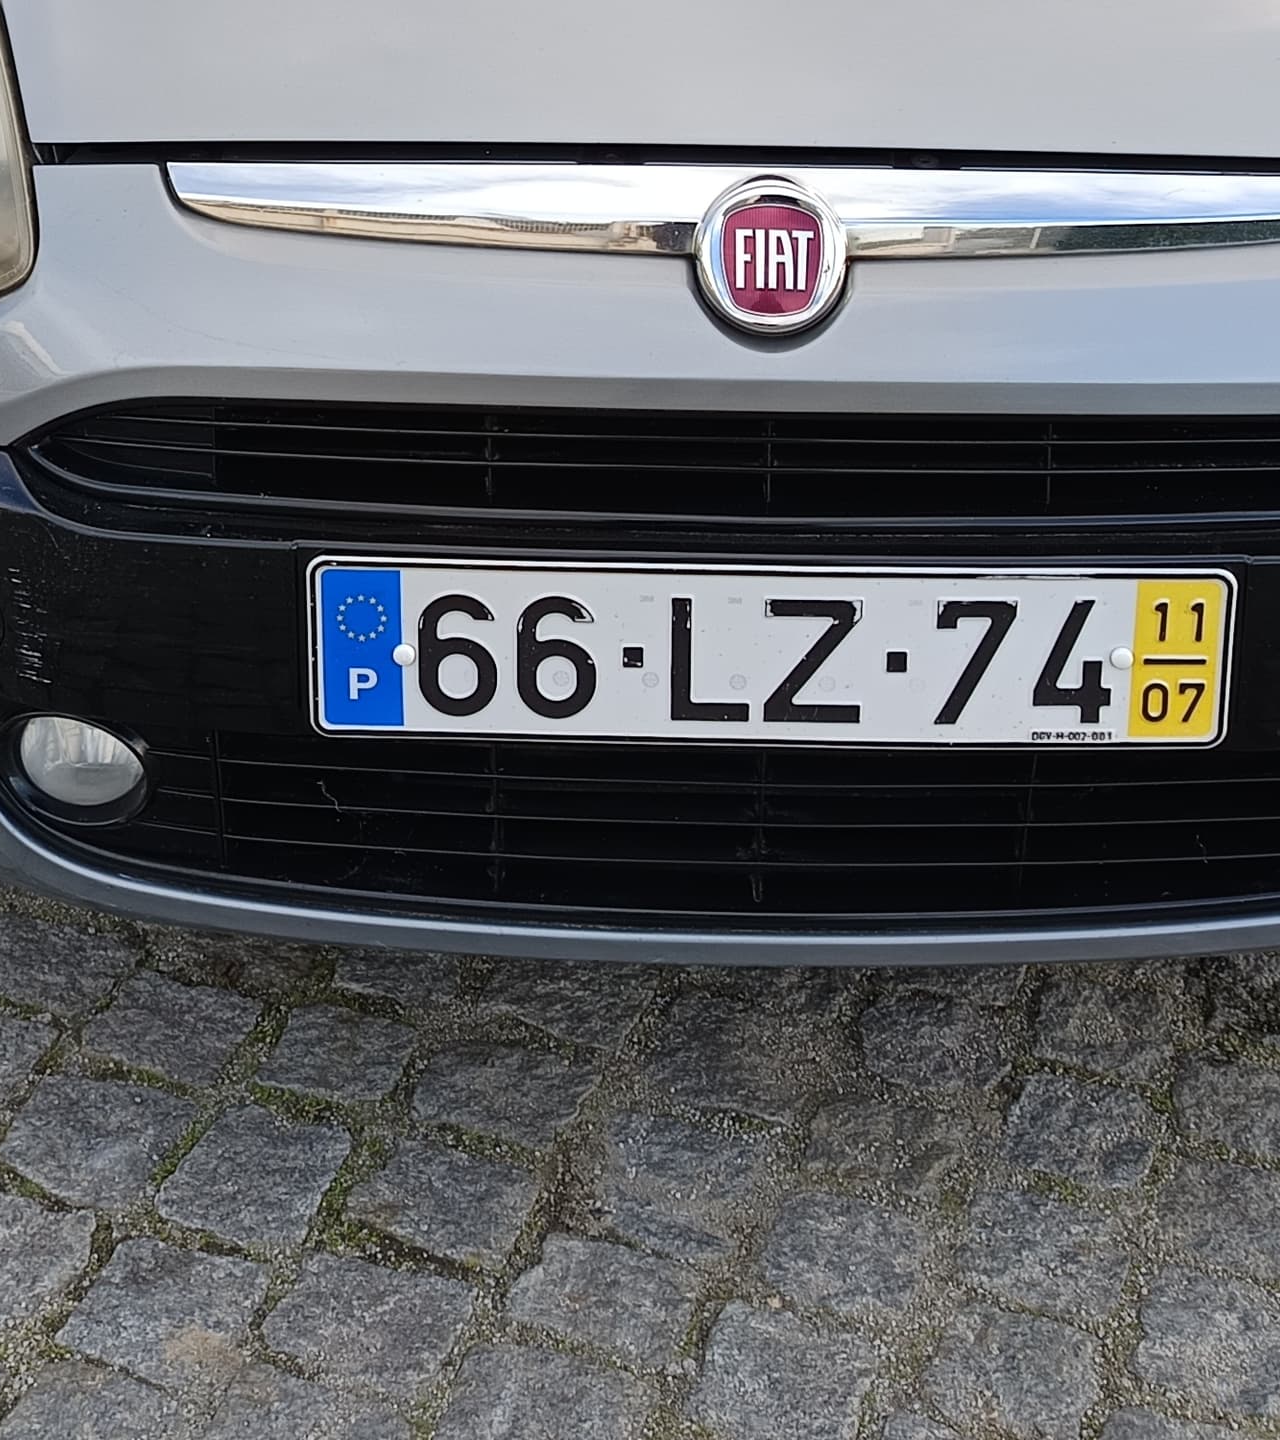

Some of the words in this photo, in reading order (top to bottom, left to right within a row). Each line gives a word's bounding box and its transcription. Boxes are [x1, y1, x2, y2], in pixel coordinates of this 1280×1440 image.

[734, 228, 815, 292] FIAT
[1154, 602, 1205, 643] 11
[348, 667, 378, 701] P
[1141, 682, 1206, 723] 07
